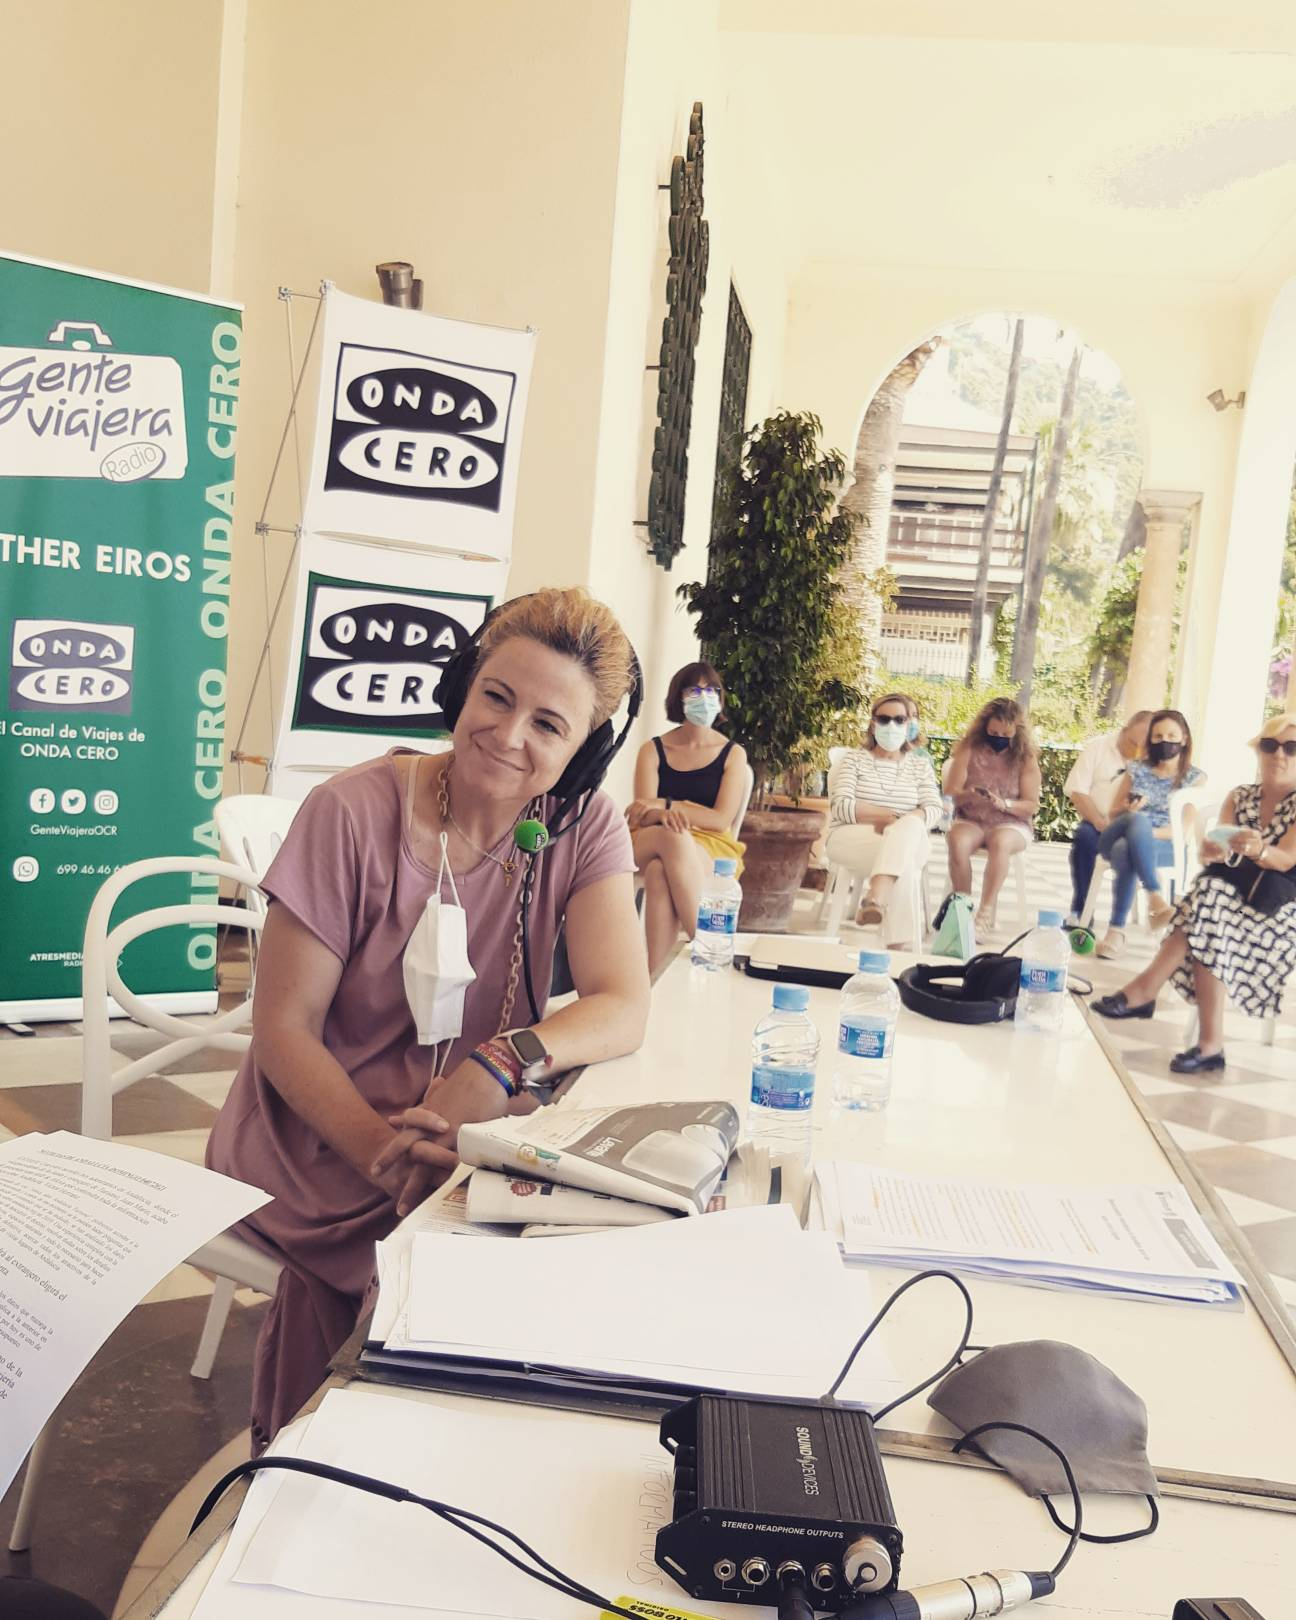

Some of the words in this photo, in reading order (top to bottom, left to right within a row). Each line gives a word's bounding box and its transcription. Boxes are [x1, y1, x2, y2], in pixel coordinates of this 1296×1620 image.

[207, 321, 243, 460] CERO
[361, 377, 483, 424] ONDA
[27, 398, 173, 452] viajera
[104, 444, 157, 480] Radio
[364, 437, 479, 481] CERO
[96, 544, 192, 582] EIROS
[200, 479, 235, 639] ONDA
[29, 638, 117, 660] ONDA
[333, 615, 457, 651] ONDA
[34, 675, 116, 697] CERO
[336, 671, 424, 705] CER
[11, 722, 55, 738] Canal
[59, 724, 78, 739] de
[82, 726, 124, 744] Viajes
[128, 728, 146, 742] de
[194, 668, 227, 799] CERO
[20, 743, 72, 759] ONDA
[76, 746, 119, 761] CERO
[30, 824, 118, 837] GenteViajeraOCR
[57, 864, 78, 875] 699
[80, 865, 95, 875] 46
[97, 865, 111, 875] 46
[796, 1426, 813, 1456] SOUND
[802, 1463, 820, 1496] DEVICES
[721, 1520, 754, 1530] STEREO
[755, 1524, 805, 1535] HEADPHONE
[806, 1529, 844, 1539] OUTPUTS
[630, 1605, 665, 1618] BOSS
